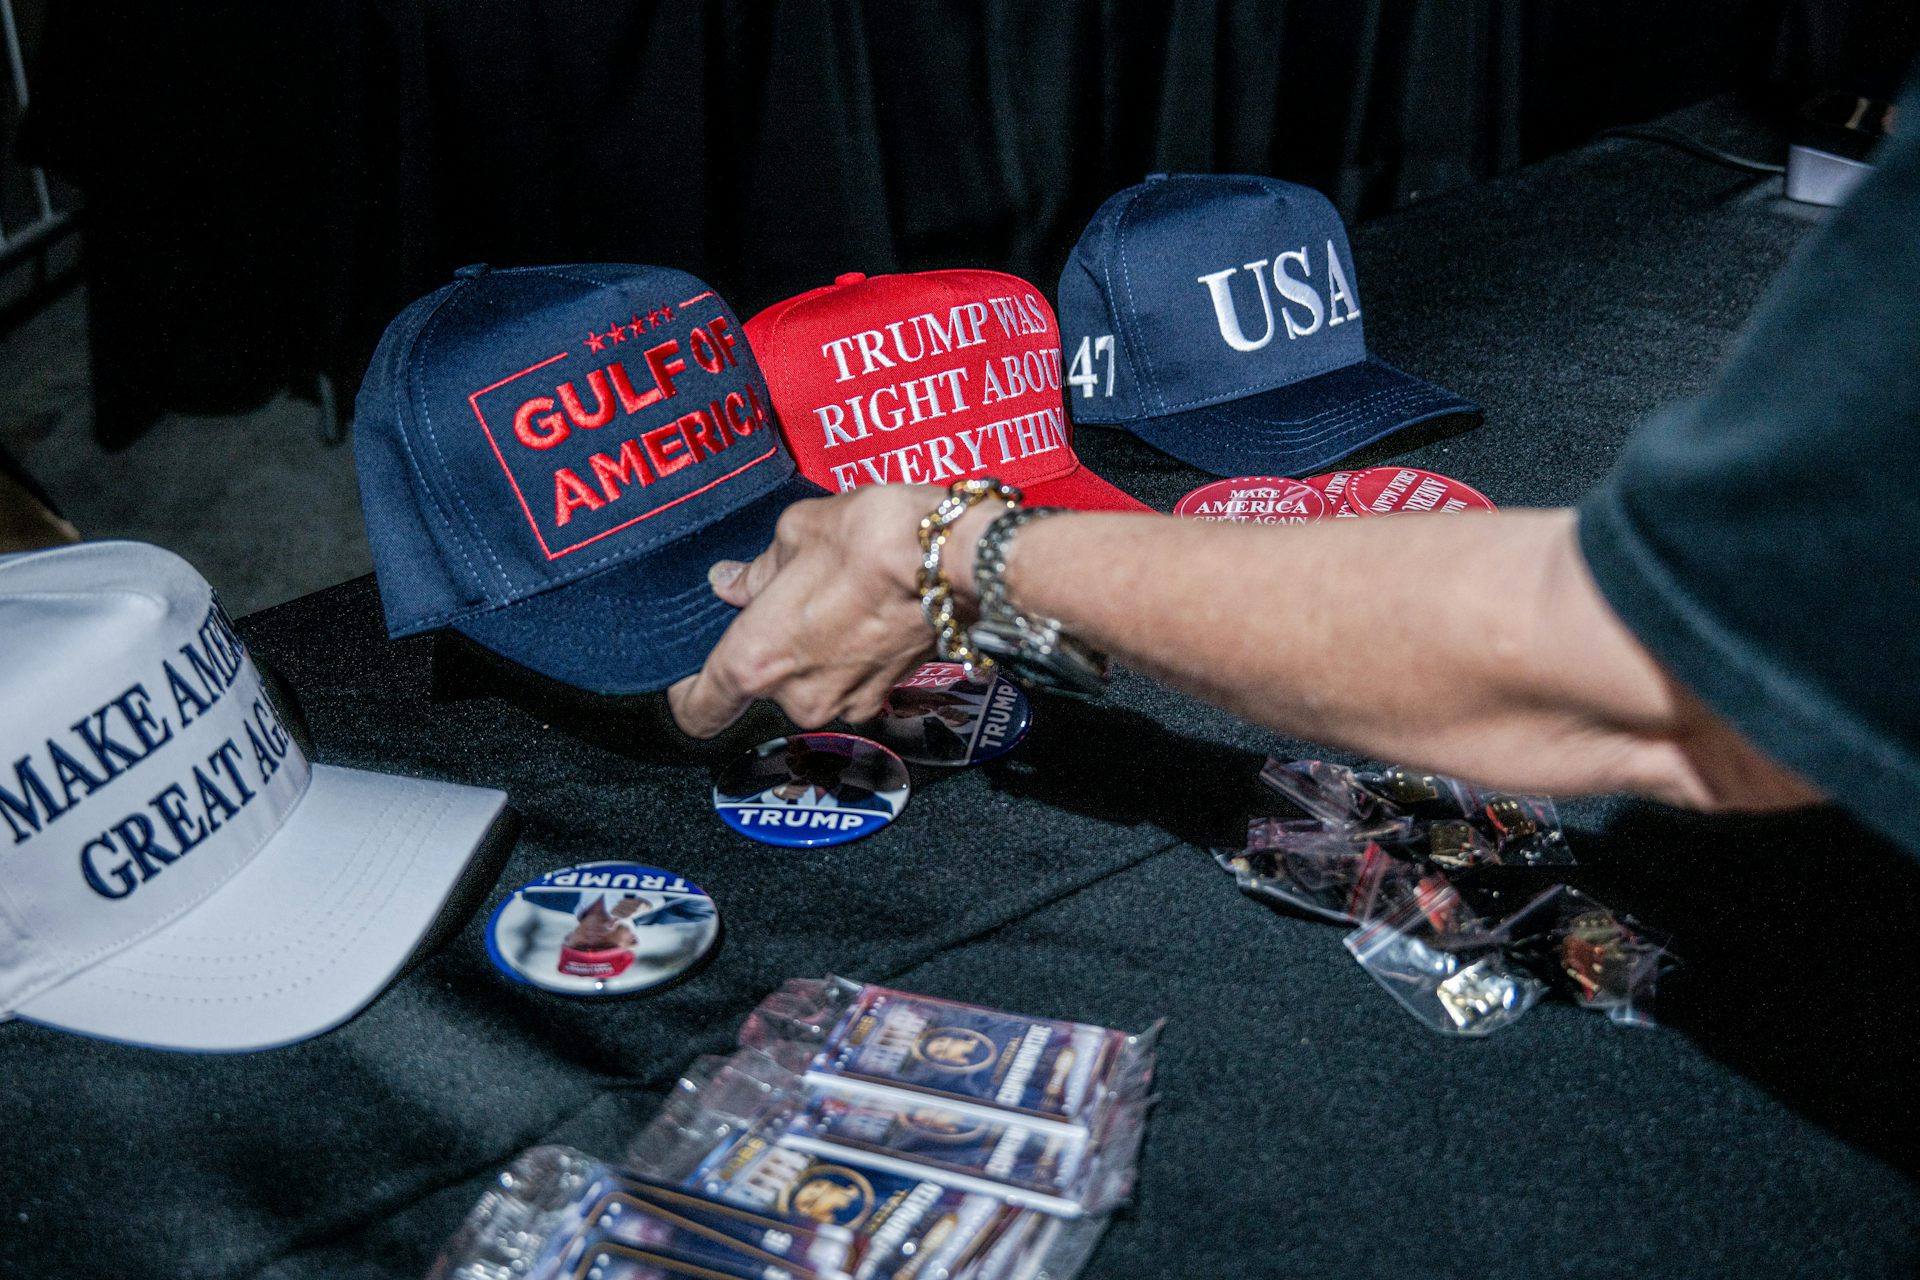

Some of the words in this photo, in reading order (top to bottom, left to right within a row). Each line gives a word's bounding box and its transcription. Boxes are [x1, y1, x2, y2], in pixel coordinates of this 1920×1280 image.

[1197, 239, 1360, 352] USA
[821, 300, 990, 384] TRUMP
[988, 293, 1049, 340] WAS
[1067, 333, 1115, 398] 47
[512, 338, 687, 451] GULF
[689, 315, 737, 374] OF
[812, 366, 971, 449] RIGHT
[981, 347, 1062, 406] ABOU
[829, 406, 1069, 494] EVERYTHIN
[1193, 500, 1309, 514] AMERICA
[1229, 489, 1281, 499] MAKE
[1402, 477, 1449, 512] AMERIC
[979, 684, 1018, 748] TRUMP
[0, 682, 174, 845] MAKE
[79, 736, 257, 901] GREAT
[737, 808, 864, 832] TRUMP
[553, 871, 690, 893] TRUMP
